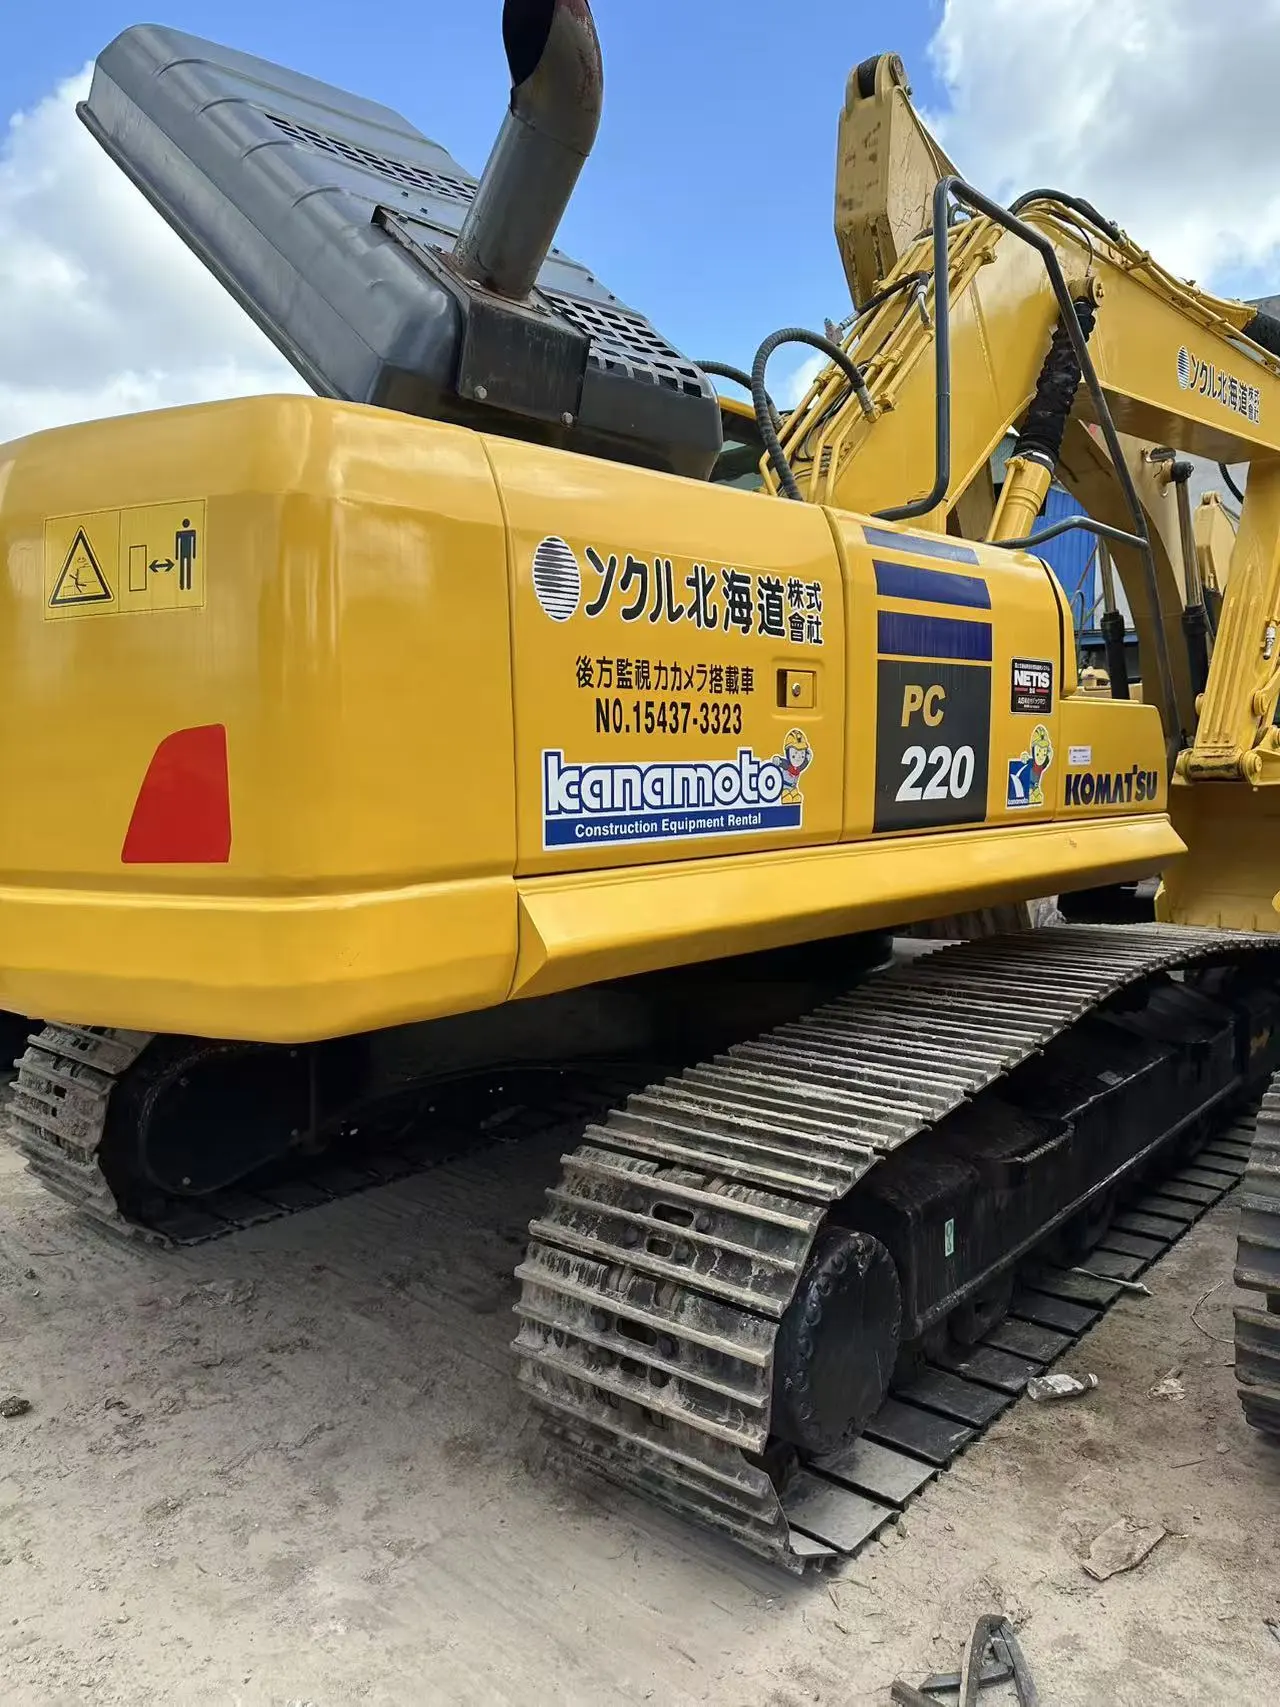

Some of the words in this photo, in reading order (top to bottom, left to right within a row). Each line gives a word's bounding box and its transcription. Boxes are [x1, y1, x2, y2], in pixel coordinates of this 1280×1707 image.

[1014, 670, 1050, 688] NETIS
[901, 684, 946, 727] PC
[545, 750, 784, 816] kanamoto
[895, 745, 976, 802] 220
[1064, 764, 1158, 806] KOMATSU
[575, 821, 658, 838] Construction
[661, 816, 724, 834] Equipment
[727, 813, 762, 826] Rental
